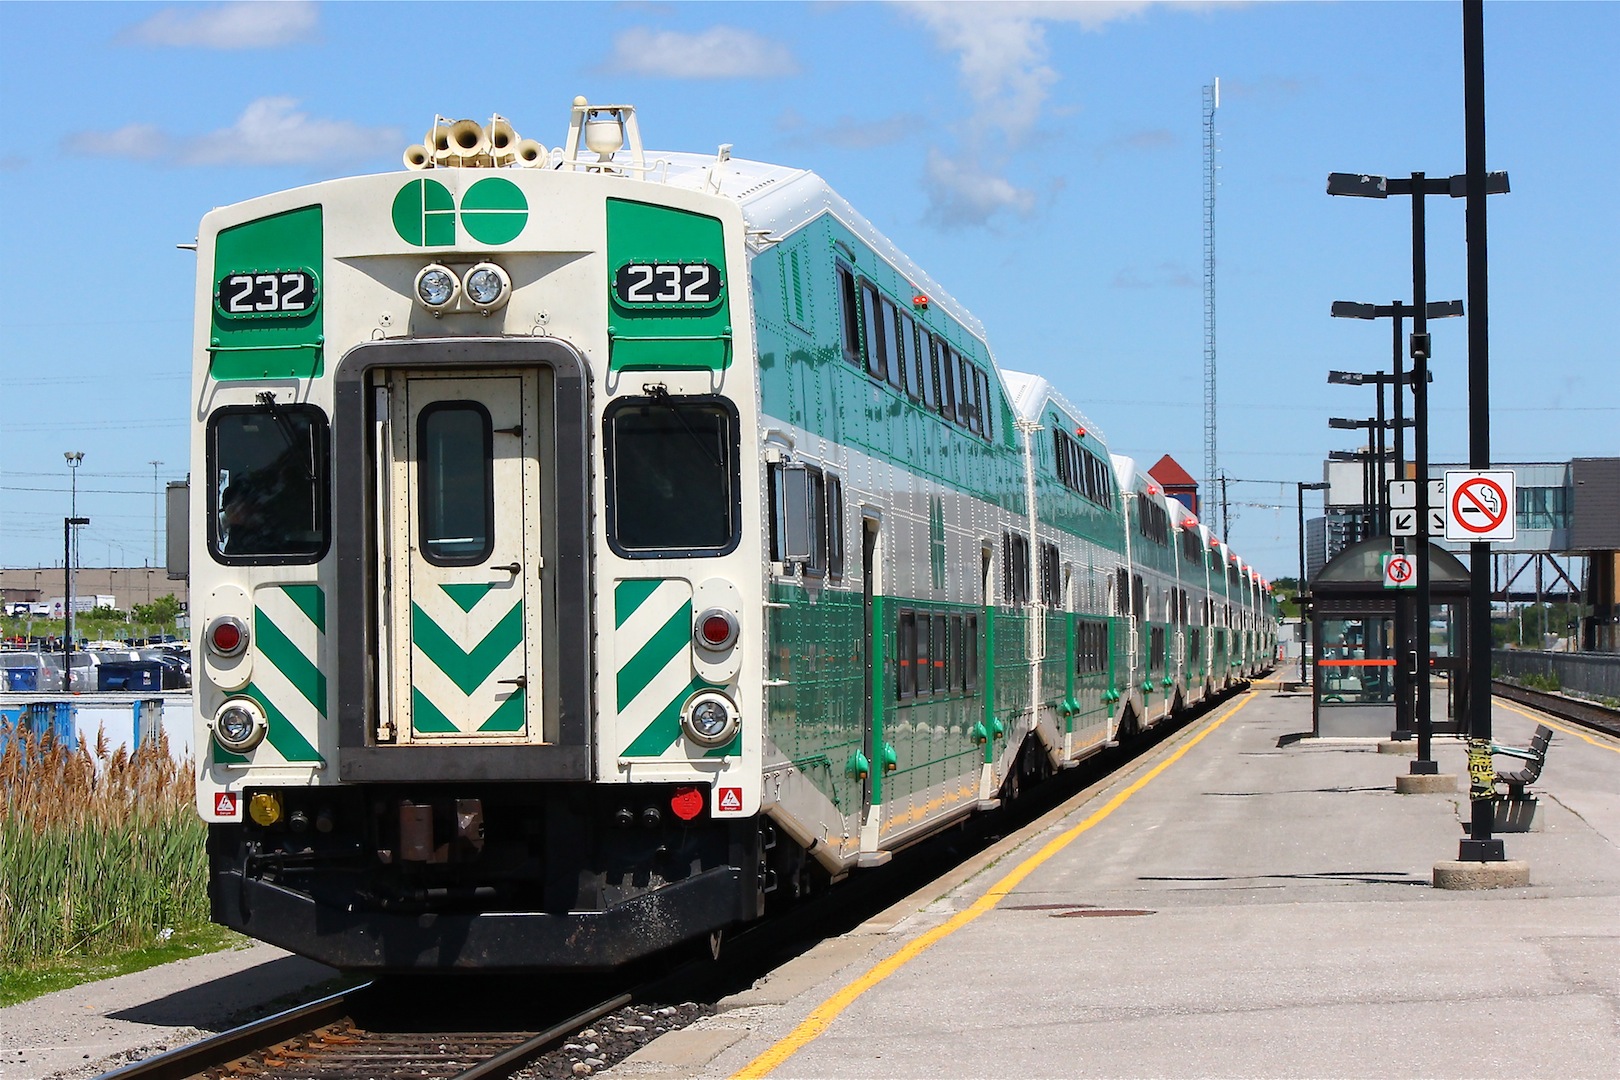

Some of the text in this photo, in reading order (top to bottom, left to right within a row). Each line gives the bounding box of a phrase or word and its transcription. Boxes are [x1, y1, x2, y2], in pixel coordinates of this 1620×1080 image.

[230, 274, 305, 312] 232
[628, 265, 710, 302] 232
[1400, 483, 1405, 494] 1
[1438, 483, 1444, 493] 2
